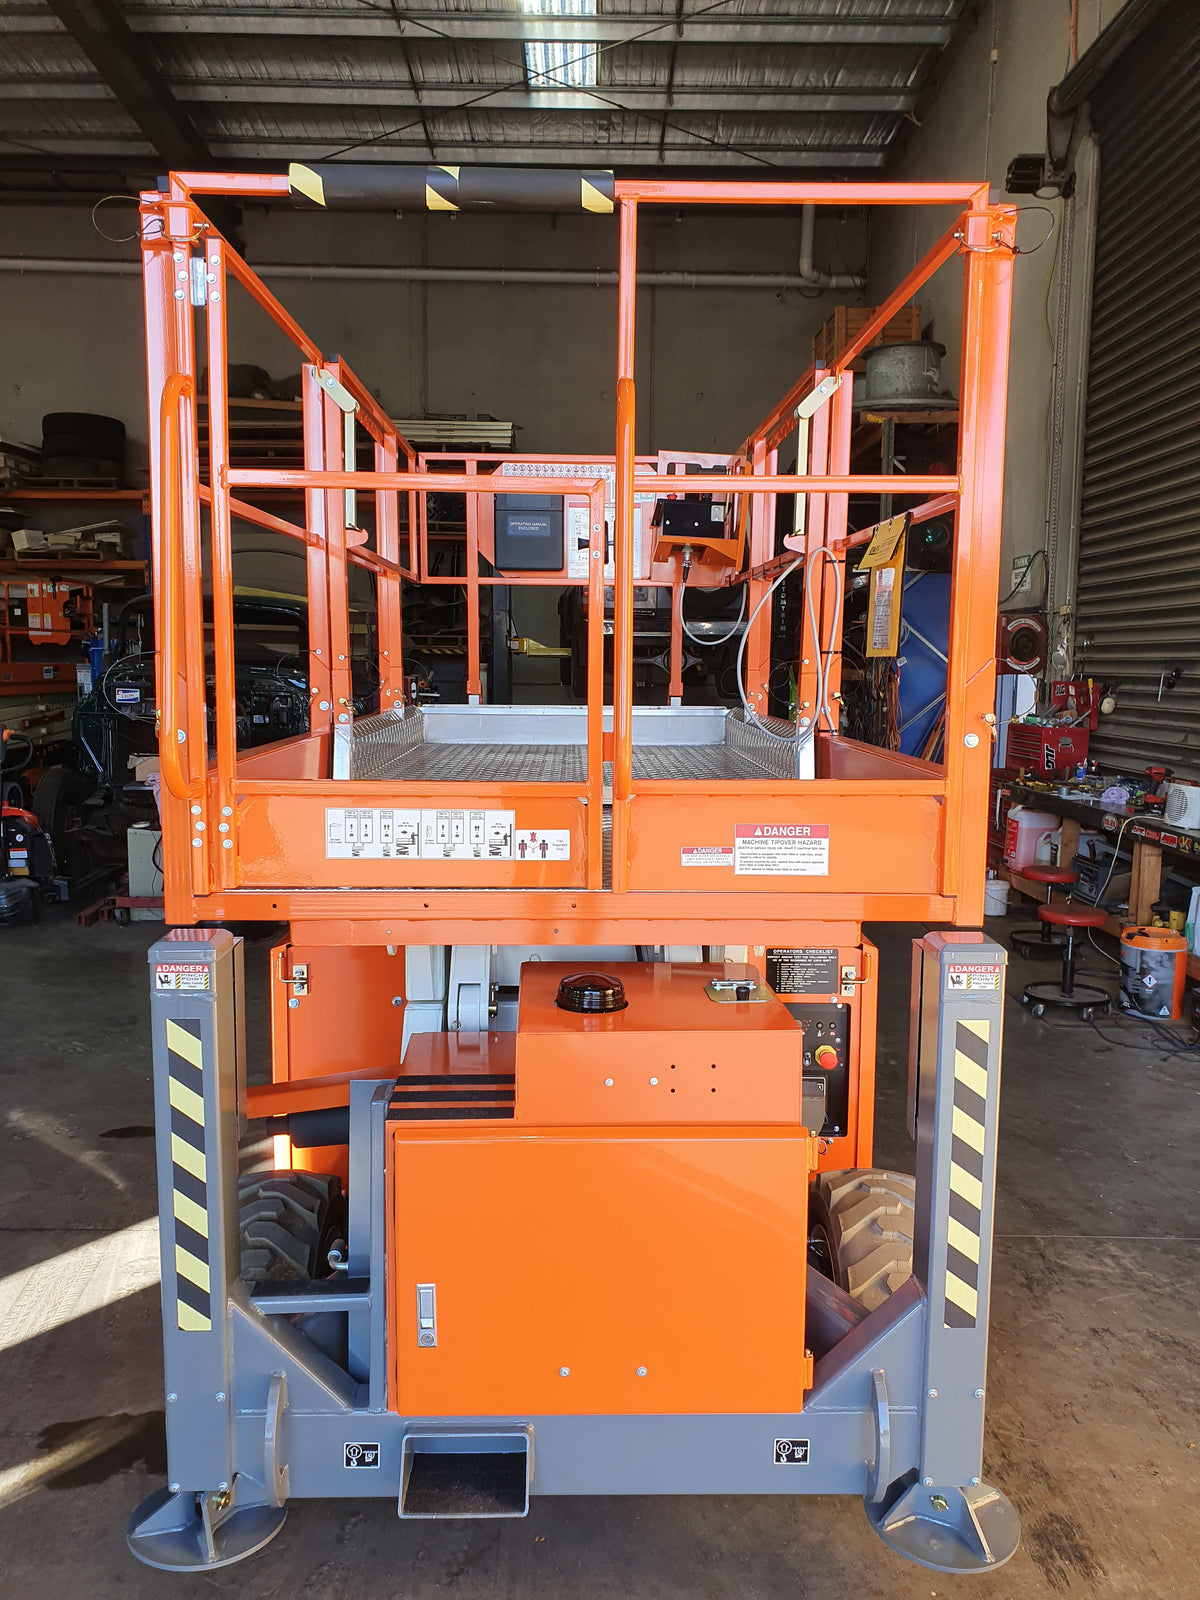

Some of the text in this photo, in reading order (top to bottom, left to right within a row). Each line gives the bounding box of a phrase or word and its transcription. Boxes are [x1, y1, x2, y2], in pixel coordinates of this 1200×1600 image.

[1055, 685, 1065, 695] JLG
[1045, 744, 1055, 770] JLG
[764, 827, 811, 836] DANGER
